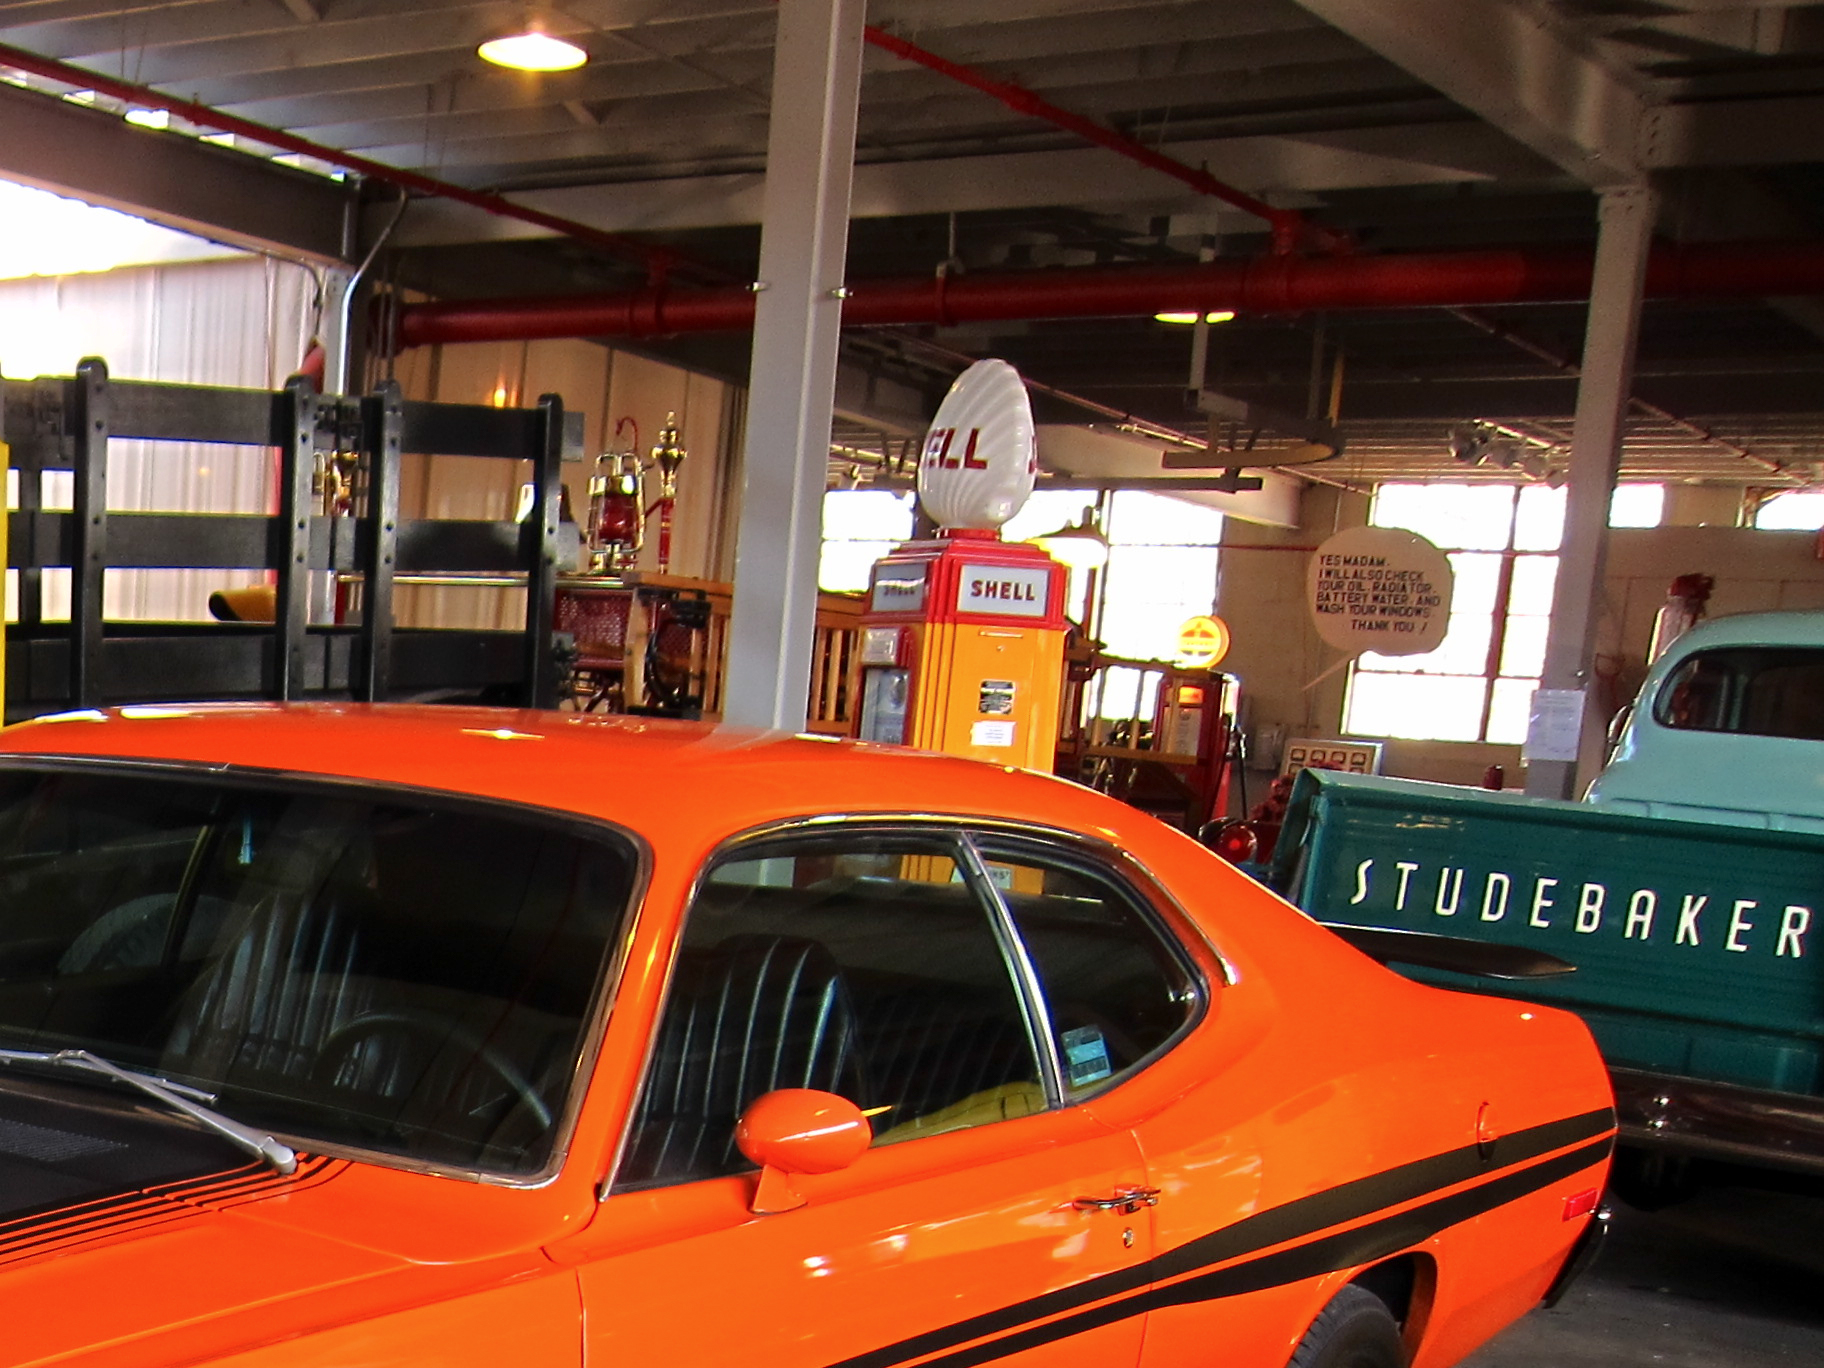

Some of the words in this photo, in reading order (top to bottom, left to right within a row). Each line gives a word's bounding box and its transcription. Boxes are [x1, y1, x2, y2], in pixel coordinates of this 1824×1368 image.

[1351, 570, 1382, 581] ALSO
[1384, 570, 1425, 582] CHECK
[970, 579, 1036, 602] SHELL
[1351, 619, 1390, 632] THANK
[1349, 858, 1813, 960] STUDEBAKER
